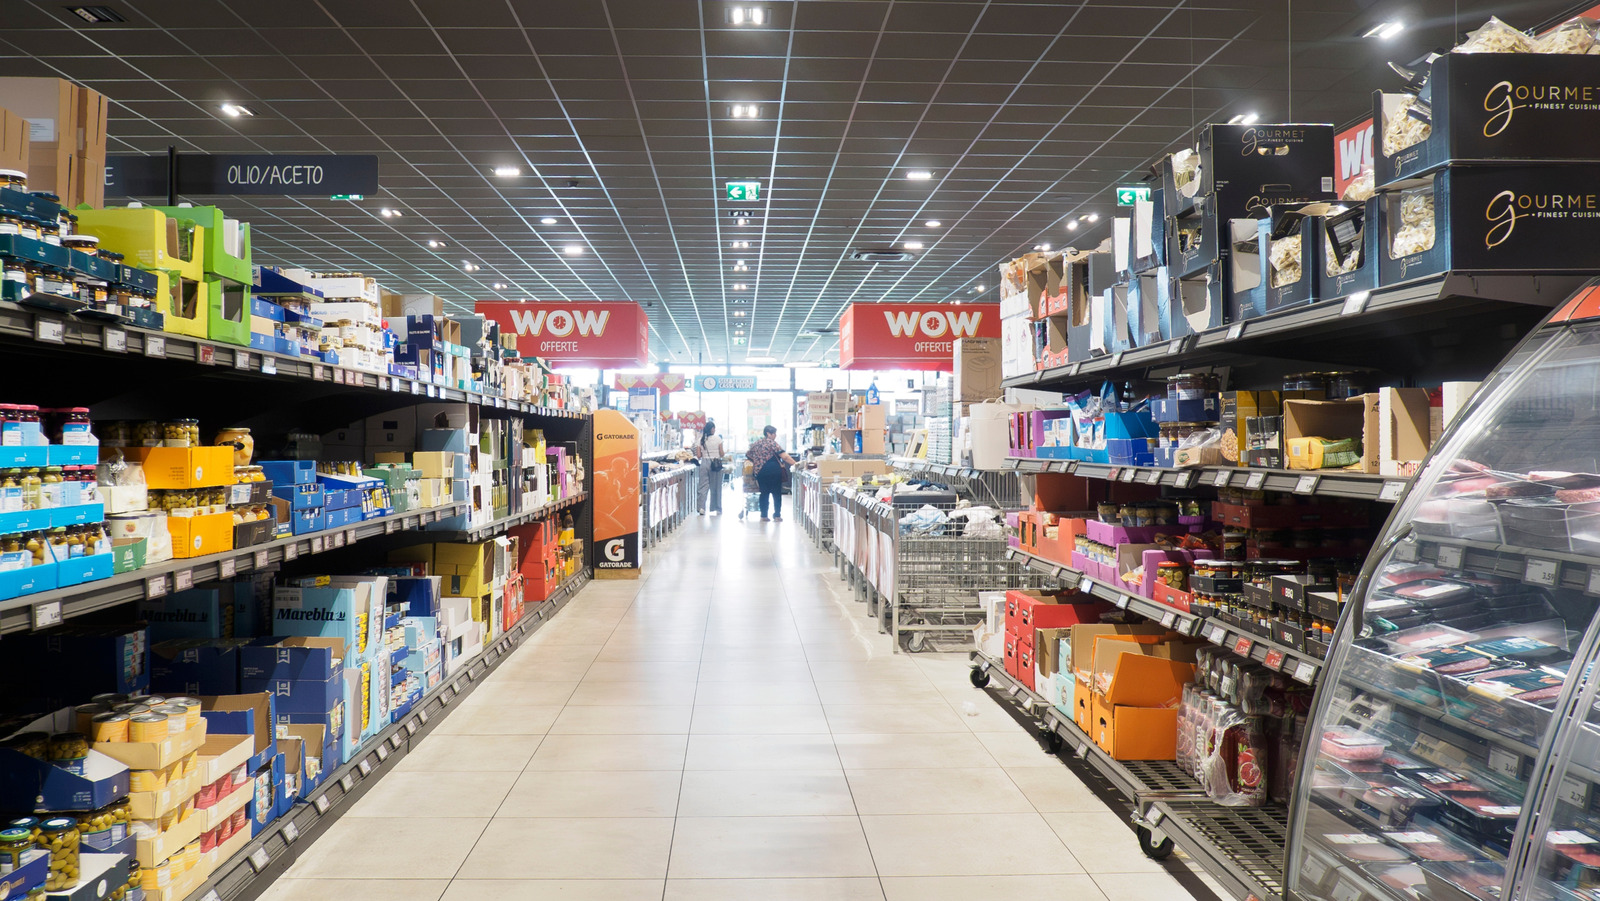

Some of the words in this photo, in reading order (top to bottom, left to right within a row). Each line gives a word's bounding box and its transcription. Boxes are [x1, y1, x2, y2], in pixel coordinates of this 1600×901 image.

[1534, 102, 1565, 110] FINEST
[227, 165, 323, 185] OLIO/ACETO
[509, 309, 611, 337] WOW
[883, 310, 983, 338] WOW
[540, 341, 579, 352] OFFERTE
[914, 341, 952, 353] OFFERTE
[685, 379, 691, 388] 4
[1285, 587, 1294, 600] BBQ
[276, 607, 335, 621] Mareblu
[1284, 631, 1293, 645] BBQ
